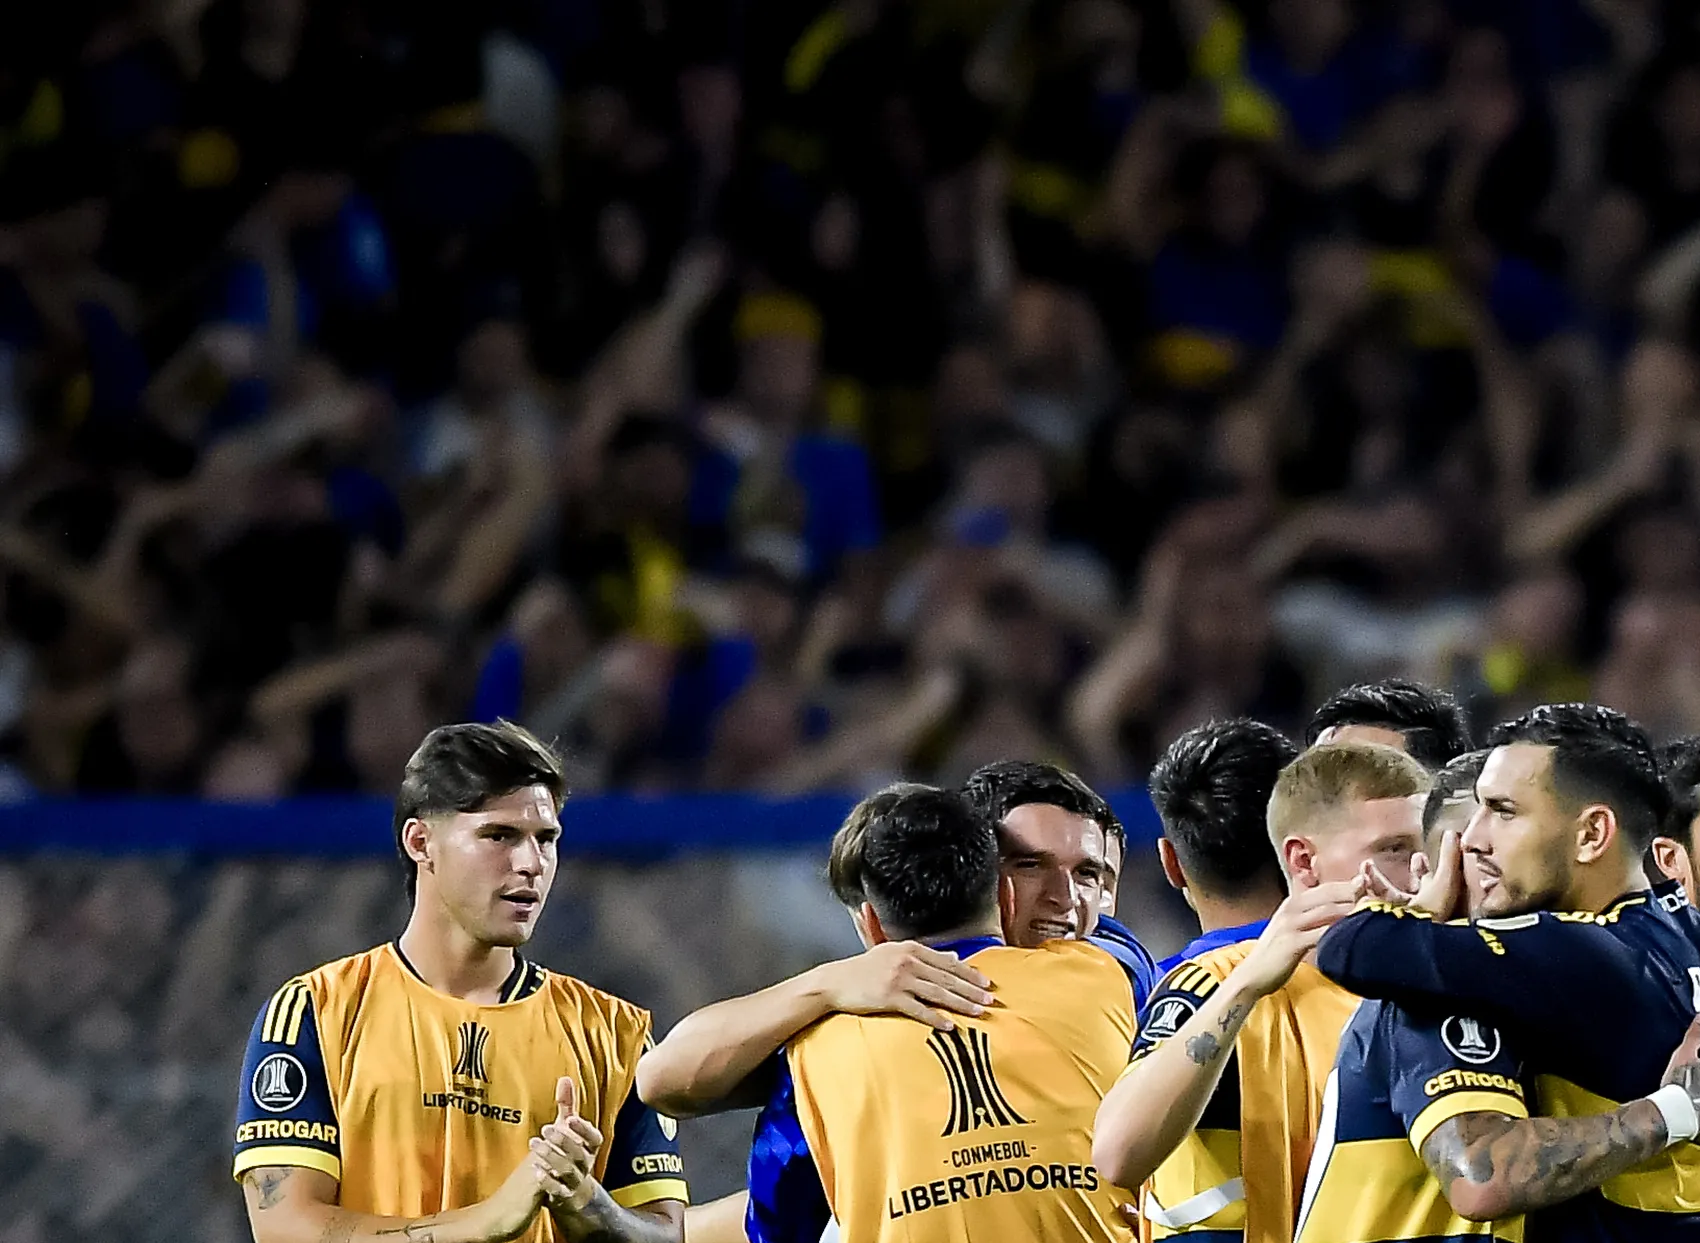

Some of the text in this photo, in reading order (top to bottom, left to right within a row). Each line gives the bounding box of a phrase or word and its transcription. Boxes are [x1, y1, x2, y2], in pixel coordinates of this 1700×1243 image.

[1424, 1069, 1524, 1098] CETROGA
[236, 1119, 338, 1145] CETROGAR
[889, 1164, 1099, 1220] LIBERTADORES
